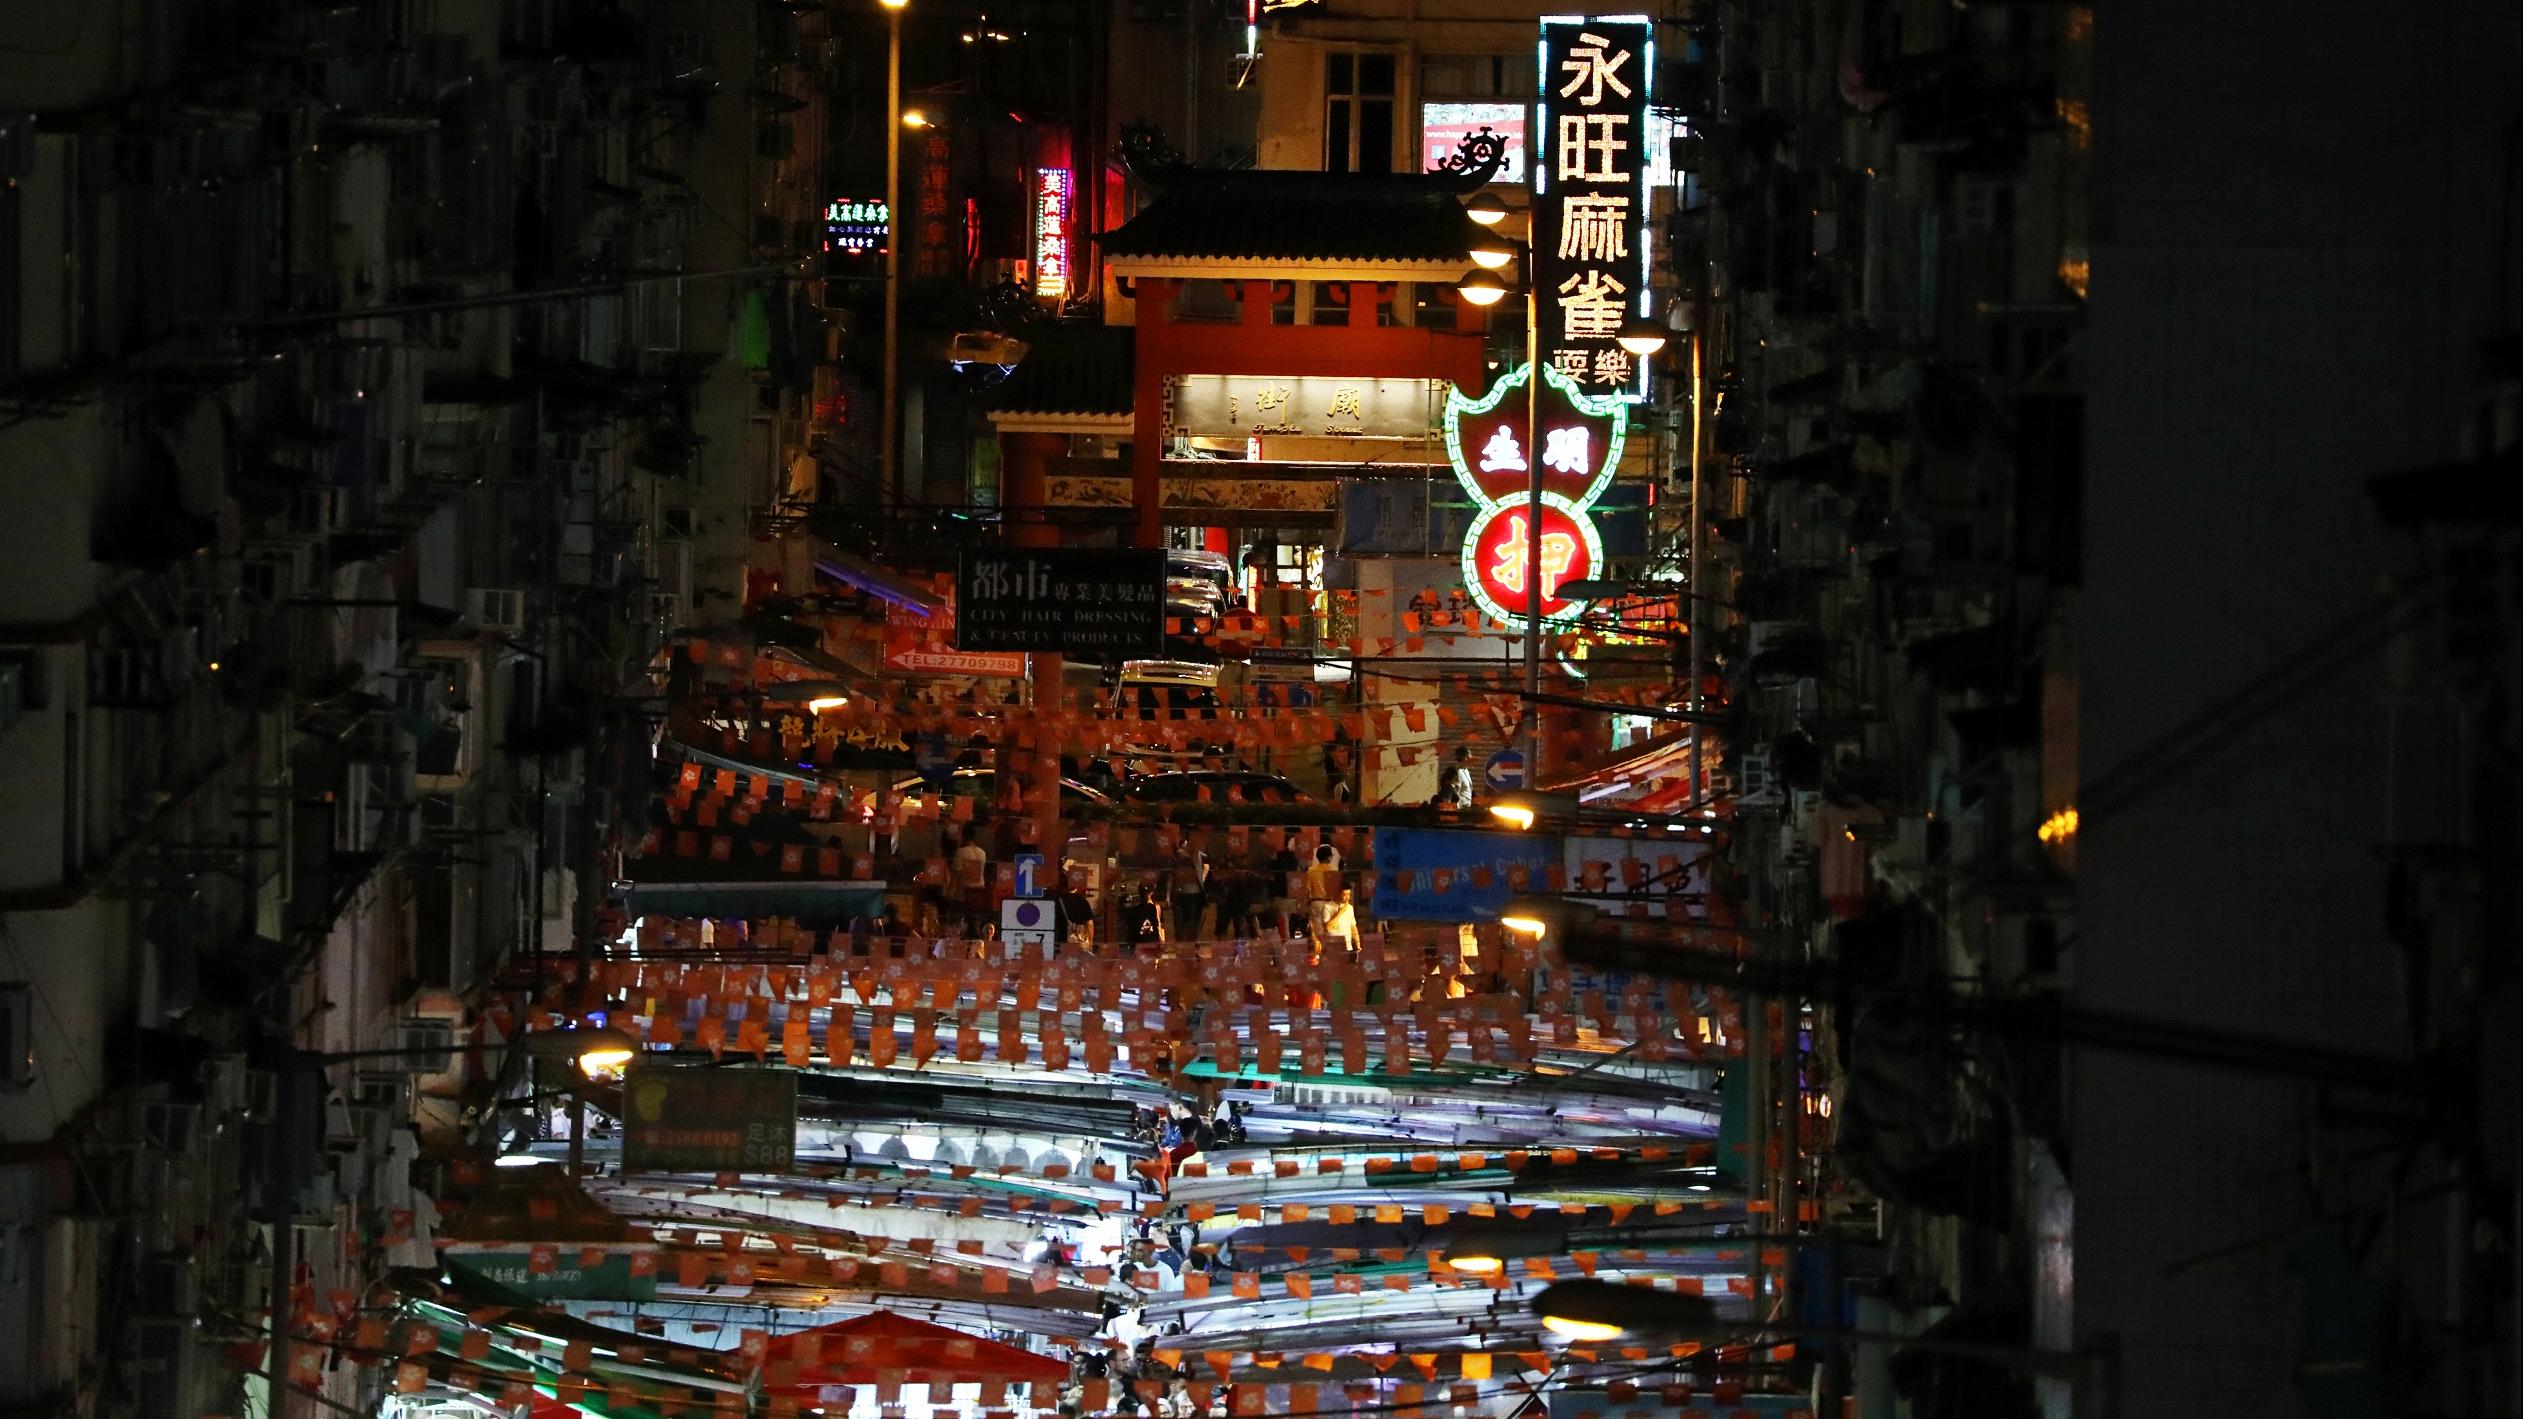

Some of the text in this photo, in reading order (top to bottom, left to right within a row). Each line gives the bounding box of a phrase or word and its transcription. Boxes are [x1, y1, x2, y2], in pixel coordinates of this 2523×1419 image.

[1558, 32, 1632, 341] 永旺麻雀
[1553, 348, 1631, 387] 耍樂
[1490, 515, 1576, 602] 押
[969, 608, 1152, 624] CITY HAIR DRESSING
[1062, 630, 1144, 645] PRODUCTS
